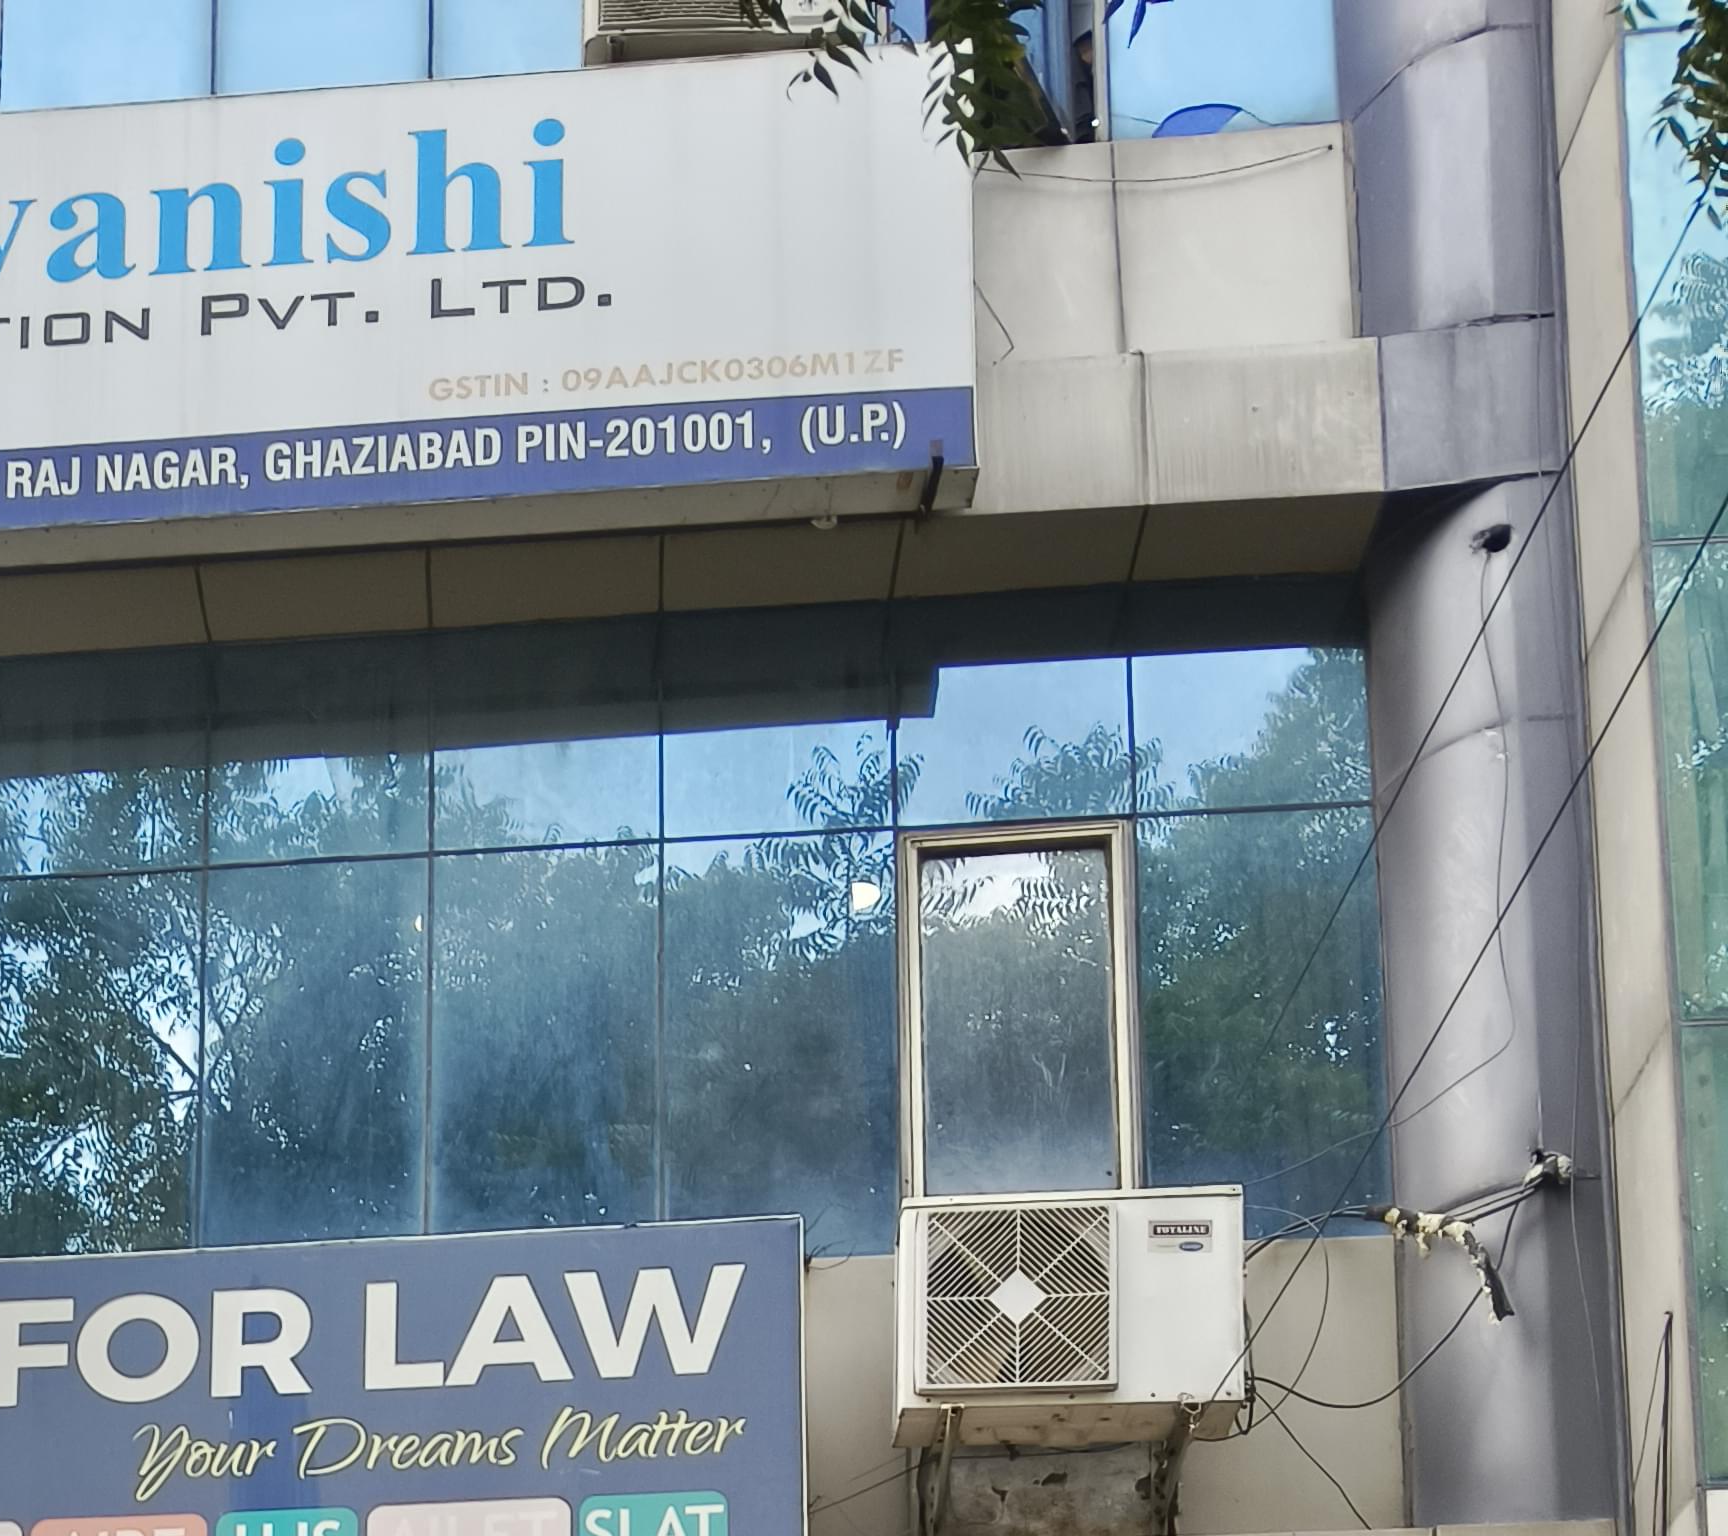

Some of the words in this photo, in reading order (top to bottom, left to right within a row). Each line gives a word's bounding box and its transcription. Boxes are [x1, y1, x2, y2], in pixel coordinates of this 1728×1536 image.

[200, 290, 380, 336] PVT.
[430, 272, 613, 320] LTD.
[428, 372, 529, 401] GSTIN
[561, 349, 904, 393] 09AAJCK0306M1ZF
[5, 455, 81, 499] RAJ
[94, 446, 249, 492] NAGAR,
[263, 427, 502, 482] GHAZIABAD
[516, 409, 772, 465] PIN-201001,
[799, 400, 906, 455] (U.P.)
[363, 1262, 747, 1391] LAW
[132, 1421, 276, 1503] Your
[292, 1416, 525, 1481] Dreams
[540, 1405, 747, 1470] Matter
